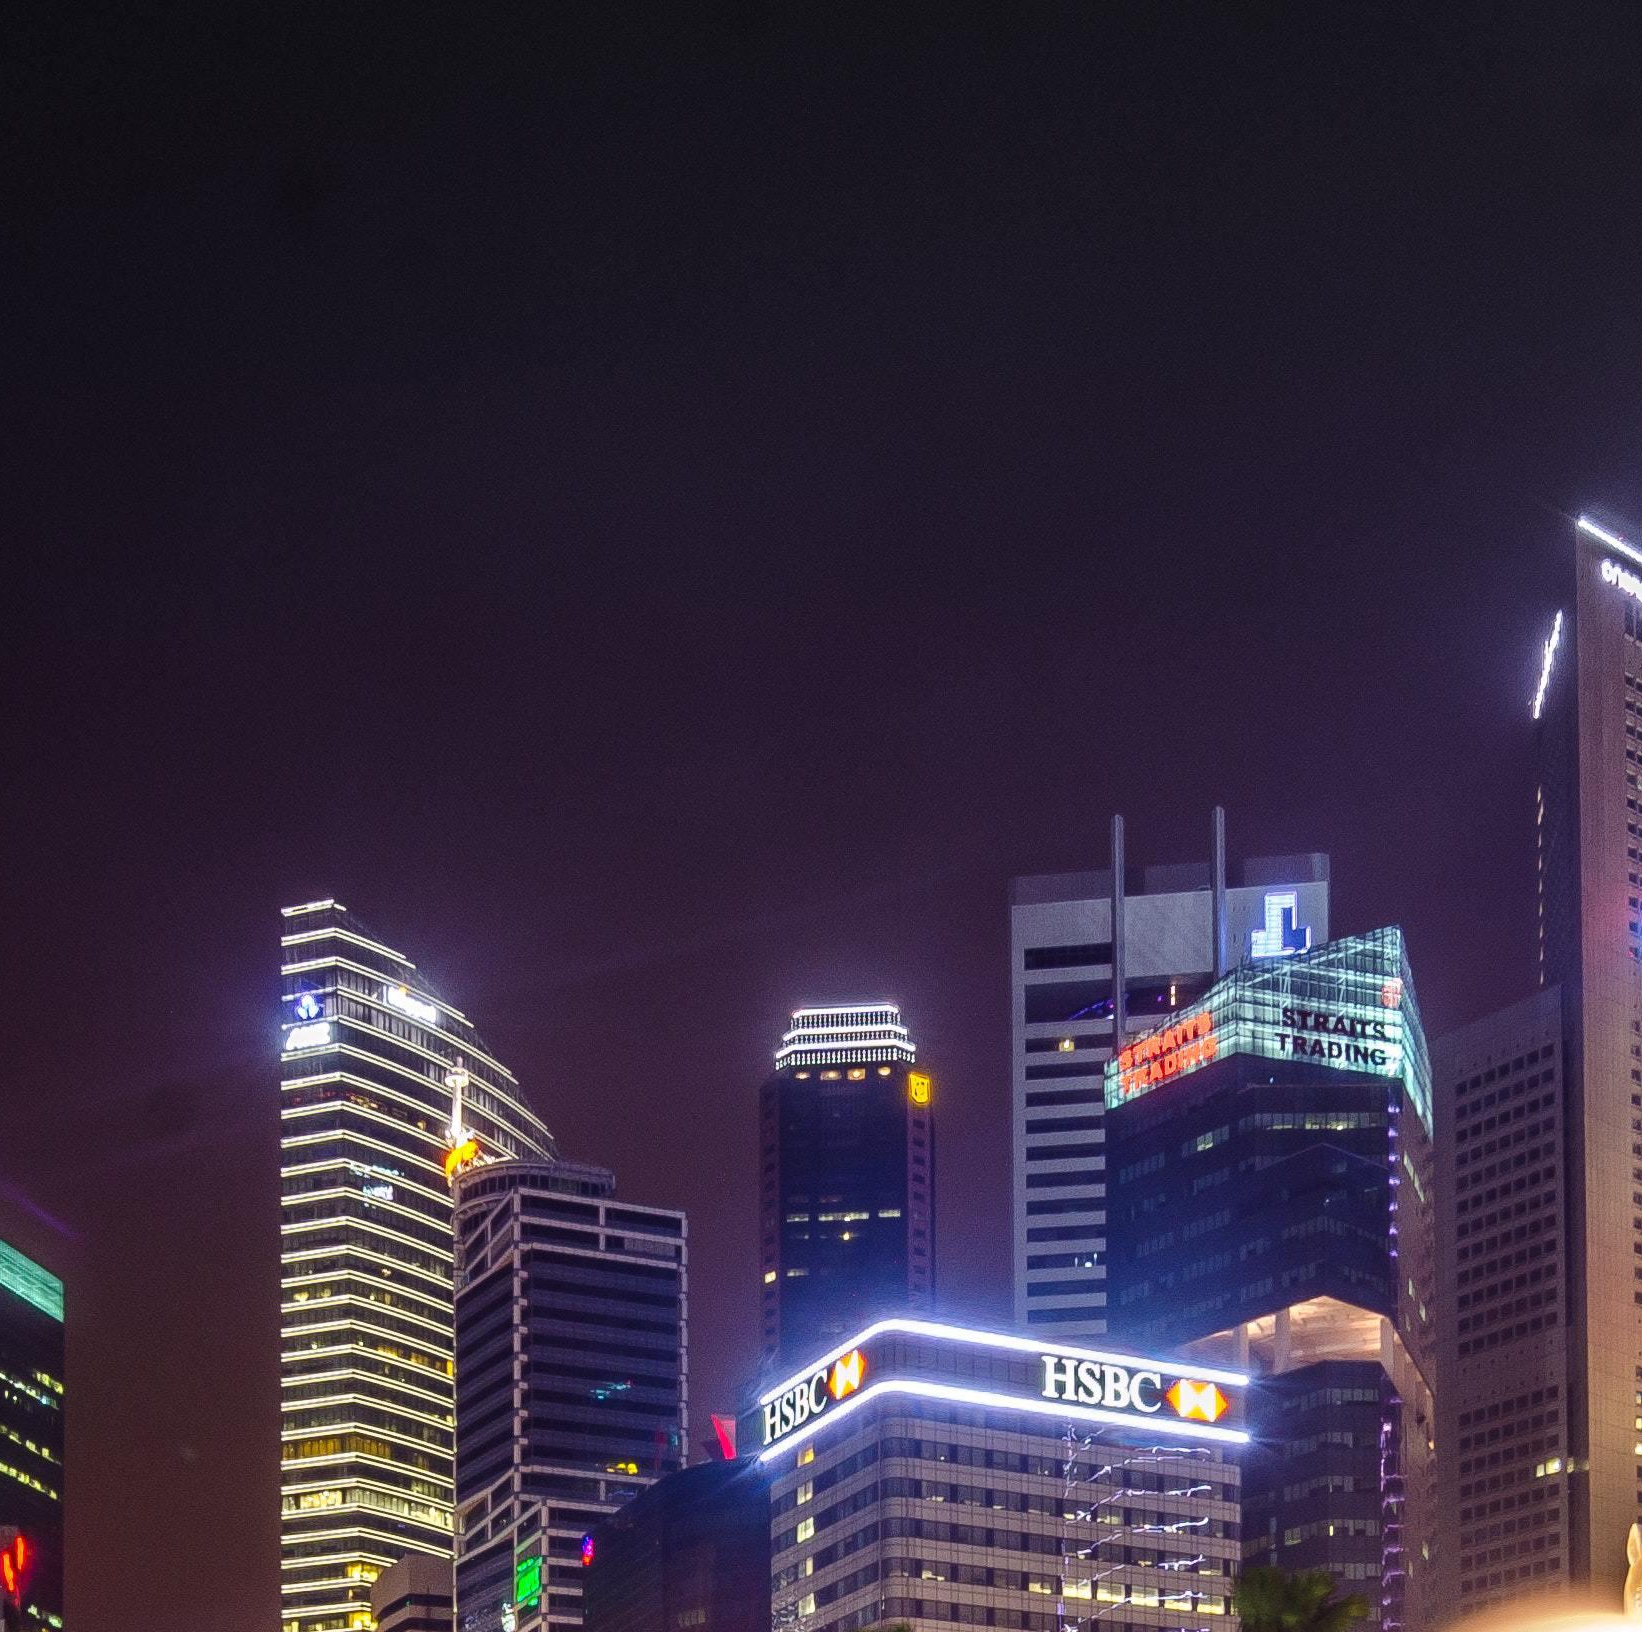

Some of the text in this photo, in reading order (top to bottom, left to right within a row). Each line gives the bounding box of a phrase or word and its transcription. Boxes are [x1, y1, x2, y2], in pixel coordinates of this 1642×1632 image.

[1118, 1011, 1212, 1072] STRAITS
[1274, 1032, 1389, 1066] TRADING
[1281, 1007, 1388, 1040] STRAITS
[1120, 1035, 1218, 1095] TRADING
[763, 1368, 828, 1446] HSBC
[1041, 1355, 1162, 1413] HSBC
